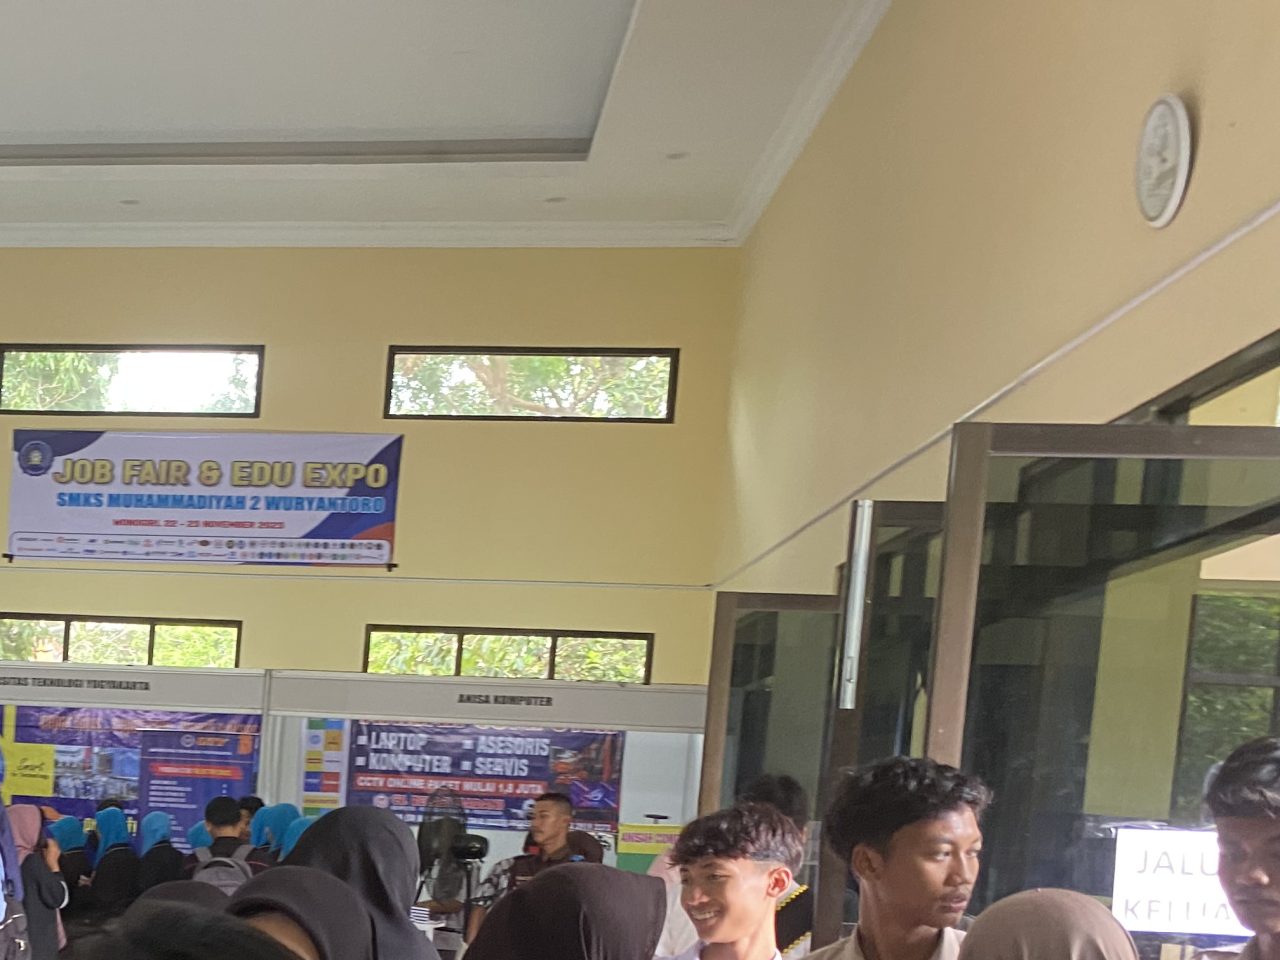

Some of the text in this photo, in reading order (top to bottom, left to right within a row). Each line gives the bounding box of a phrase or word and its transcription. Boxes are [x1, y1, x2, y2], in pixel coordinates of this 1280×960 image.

[52, 458, 388, 489] JOB FAIR & EDU EXPO
[56, 492, 386, 513] SMKS MUHAMMADIYAH 2 WURYANTORO
[457, 693, 553, 707] ANISA KOMPUTER
[370, 731, 551, 756] LAPTOP ASESORIS
[368, 753, 530, 777] KOMPUTER SERVIS
[1136, 850, 1219, 877] JALU
